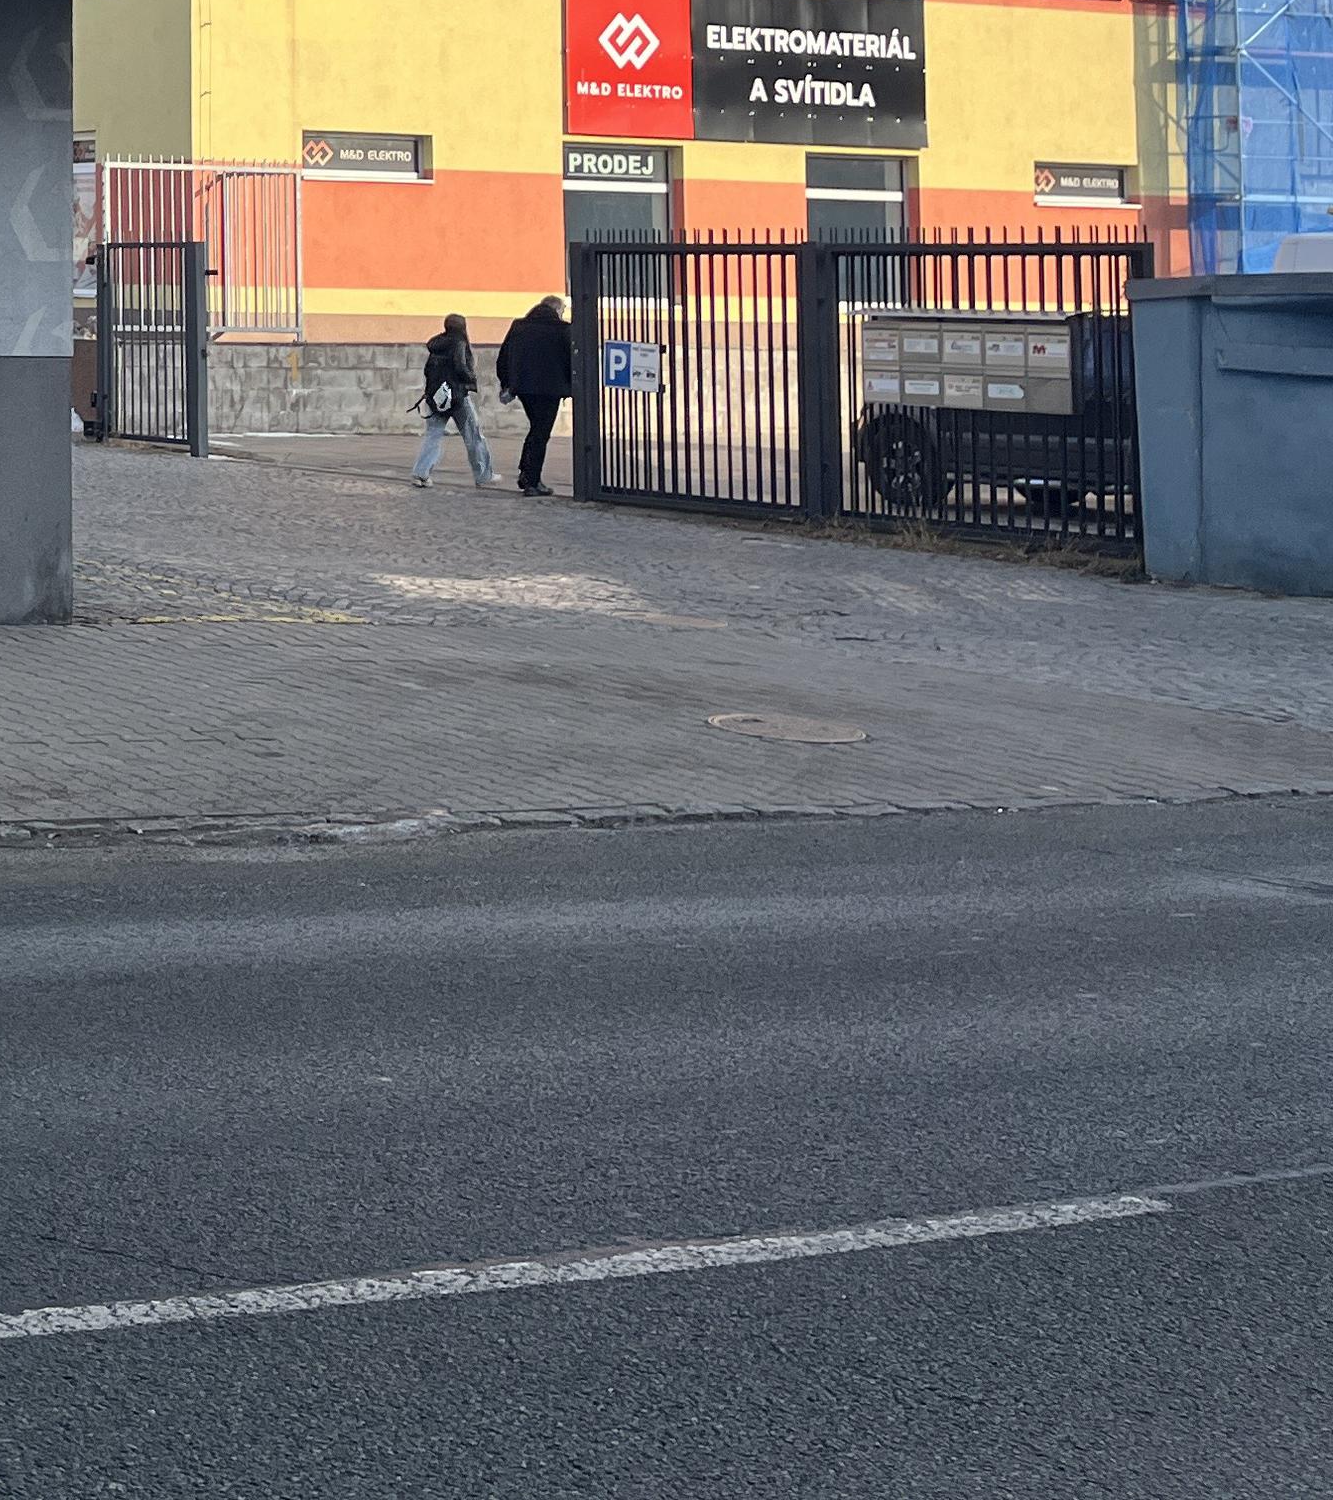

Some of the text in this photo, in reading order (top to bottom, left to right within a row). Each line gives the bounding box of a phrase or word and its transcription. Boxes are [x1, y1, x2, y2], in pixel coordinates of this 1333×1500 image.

[705, 23, 917, 61] ELEKTROMATERIÁL
[576, 81, 683, 100] M&D ELEKTRO
[749, 73, 876, 108] A SVÍTIDLA
[339, 149, 412, 162] M&D ELEKTRO
[567, 152, 655, 176] PRODEJ
[609, 348, 628, 381] P
